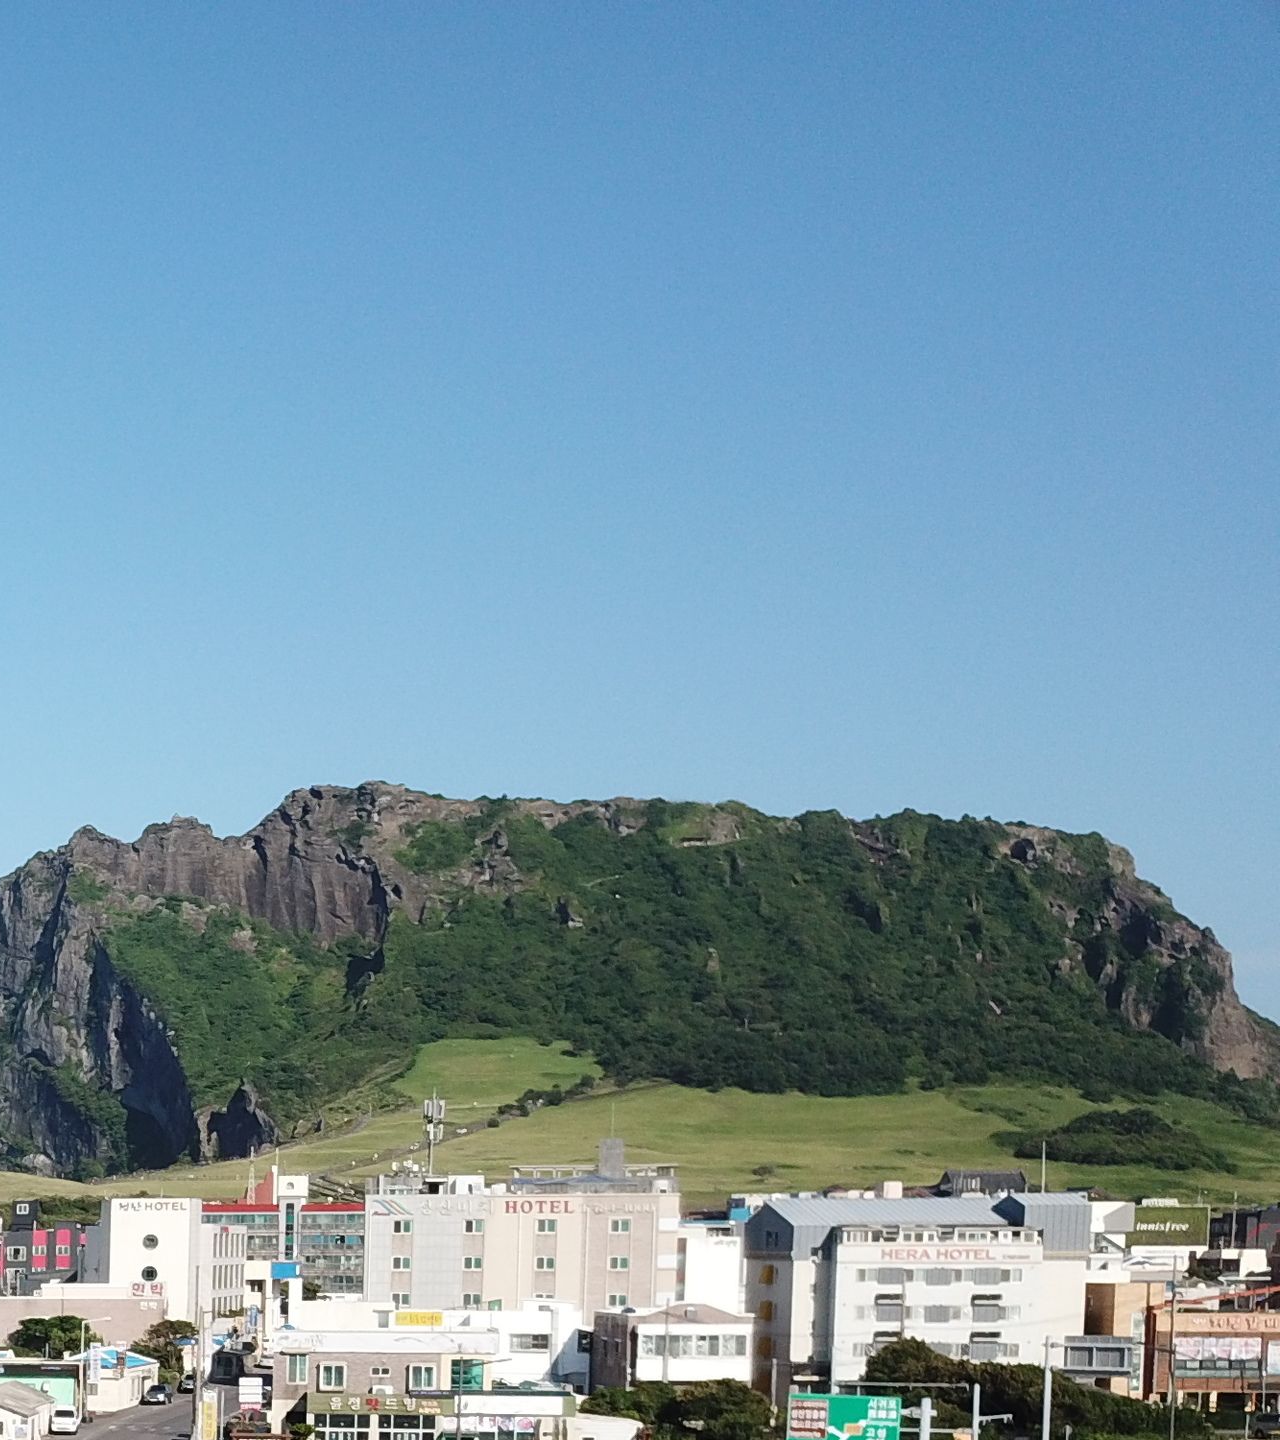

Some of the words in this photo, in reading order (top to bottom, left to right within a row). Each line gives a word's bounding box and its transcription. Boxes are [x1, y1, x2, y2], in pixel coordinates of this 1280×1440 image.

[144, 1201, 188, 1211] HOTEL
[504, 1200, 575, 1214] HOTEL
[1136, 1221, 1190, 1233] innisfree
[880, 1248, 931, 1261] HERA
[935, 1248, 997, 1261] HOTEL
